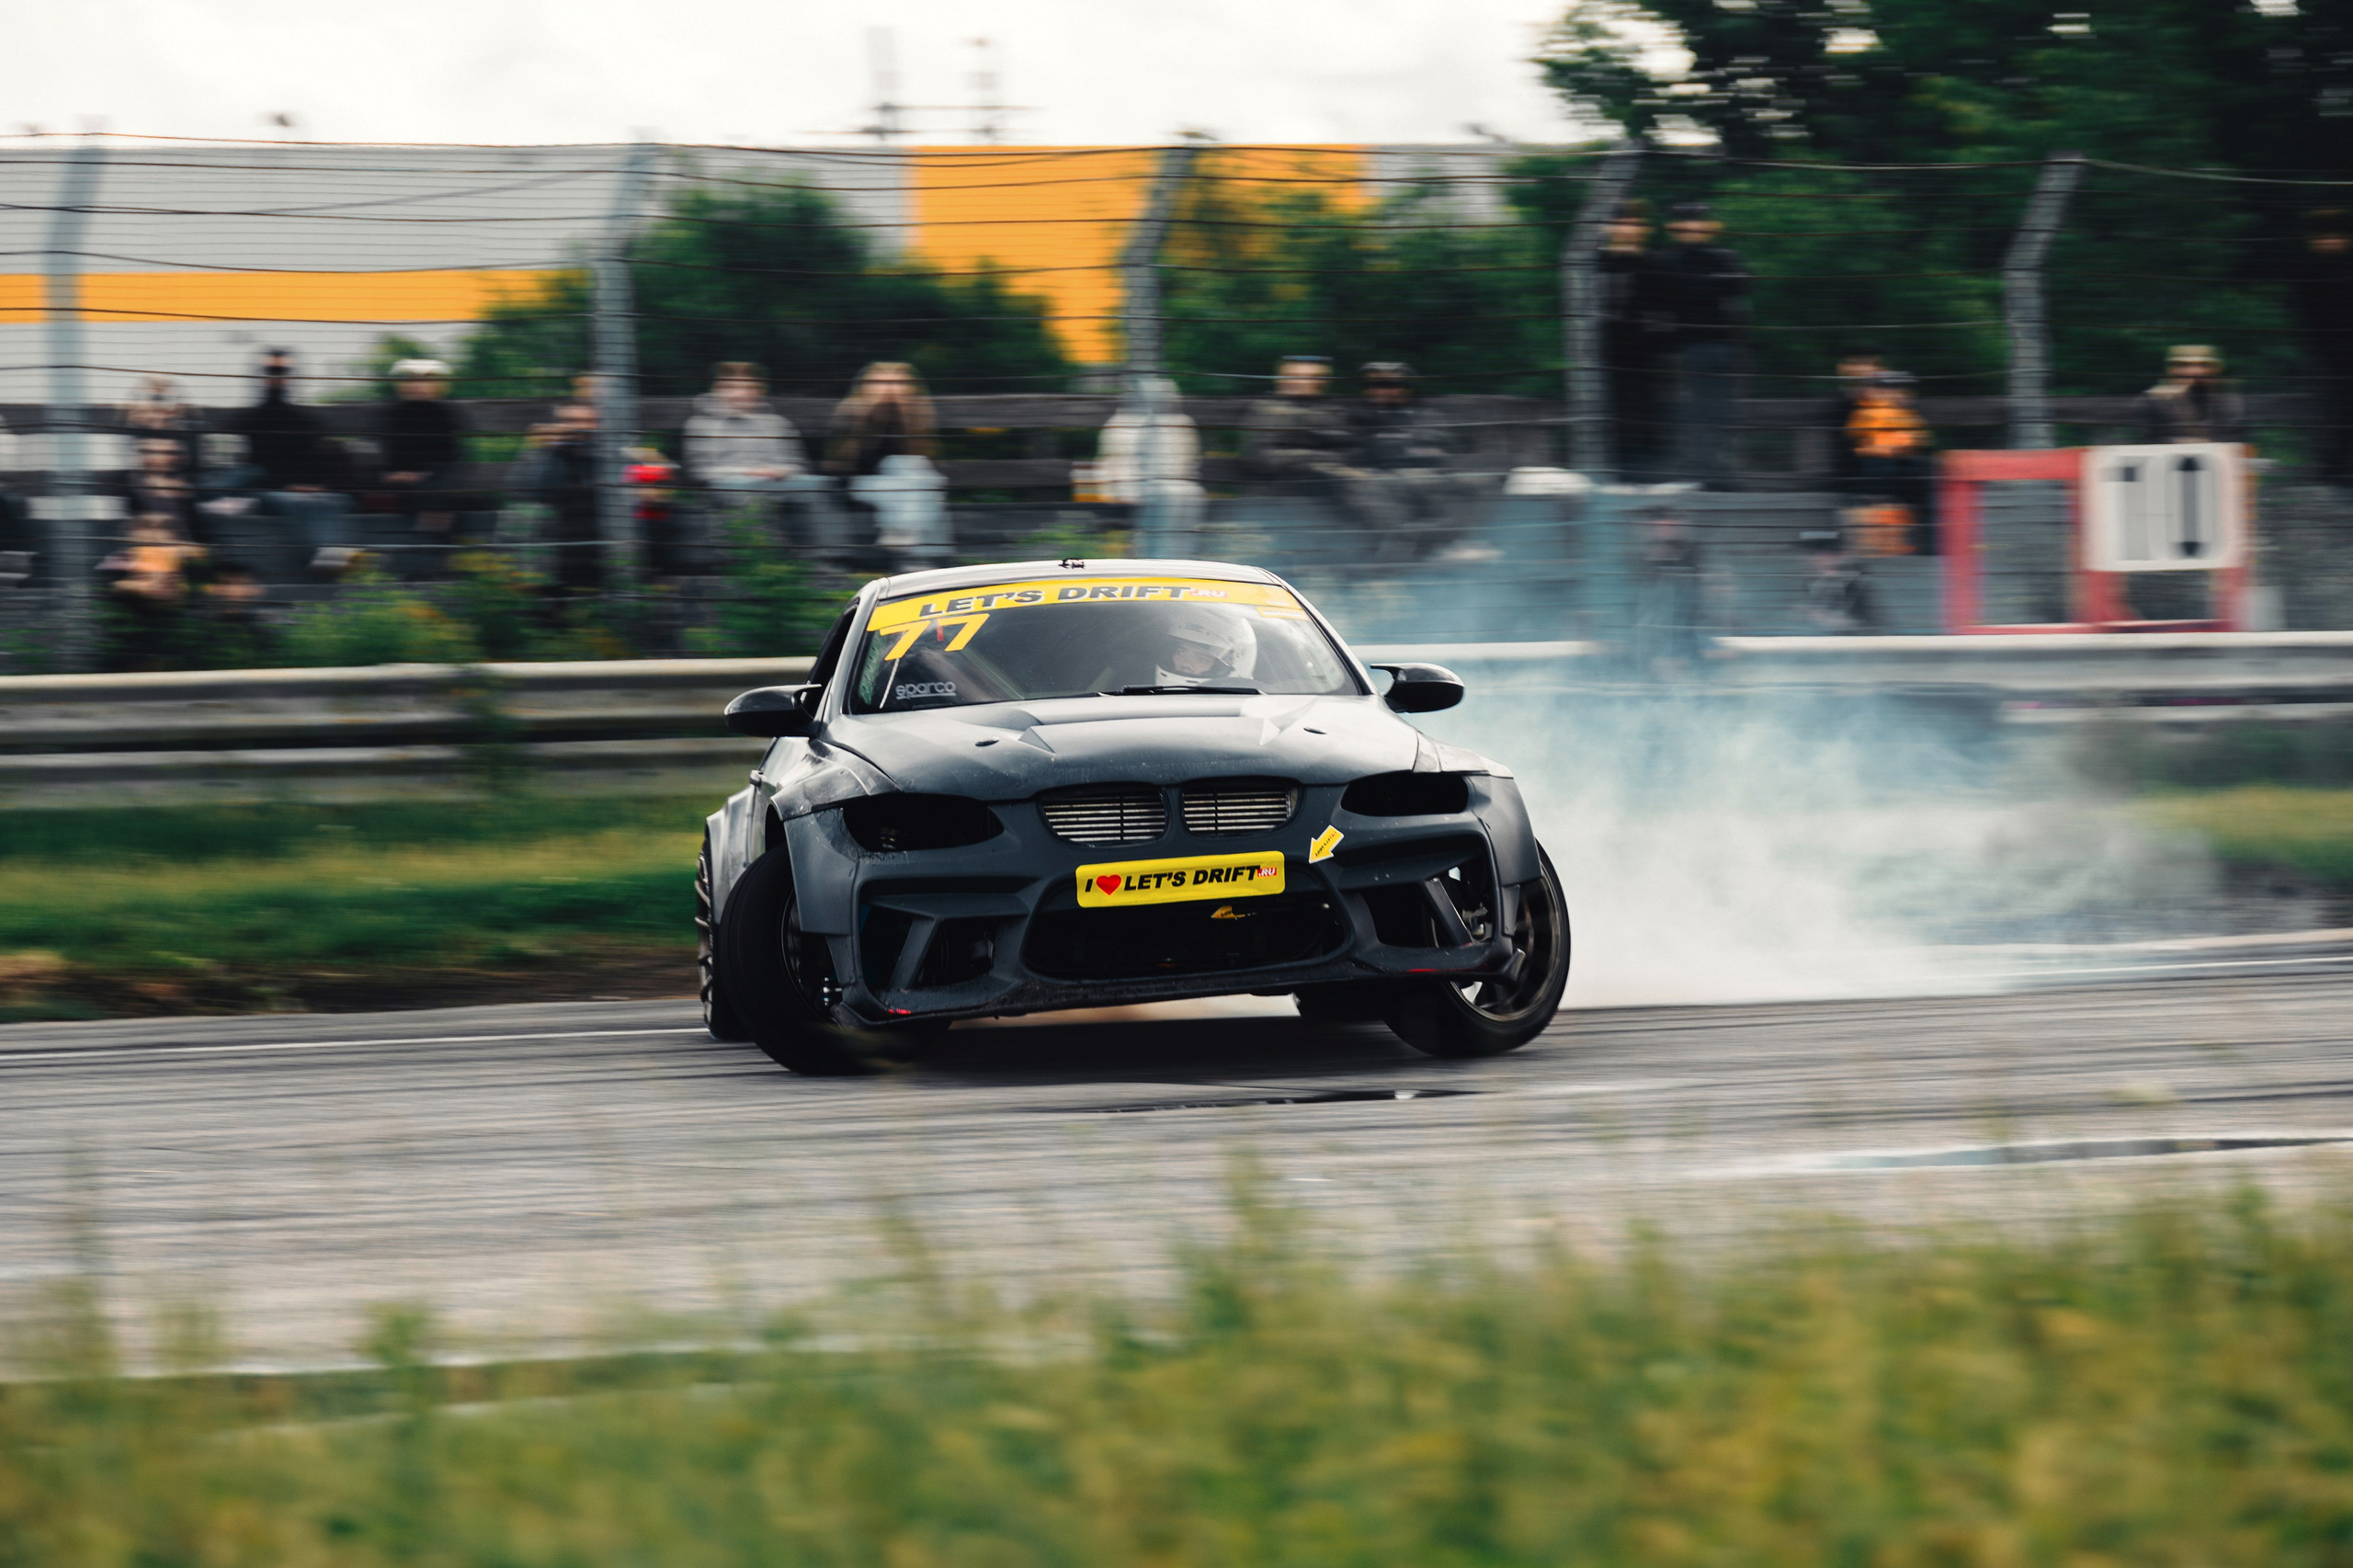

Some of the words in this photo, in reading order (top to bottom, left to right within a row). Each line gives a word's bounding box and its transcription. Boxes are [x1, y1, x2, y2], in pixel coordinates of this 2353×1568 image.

[919, 590, 1045, 619] LET'S
[880, 613, 990, 661] 77
[895, 681, 957, 699] sparco
[1085, 879, 1094, 892] I
[1124, 871, 1186, 892] LET'S
